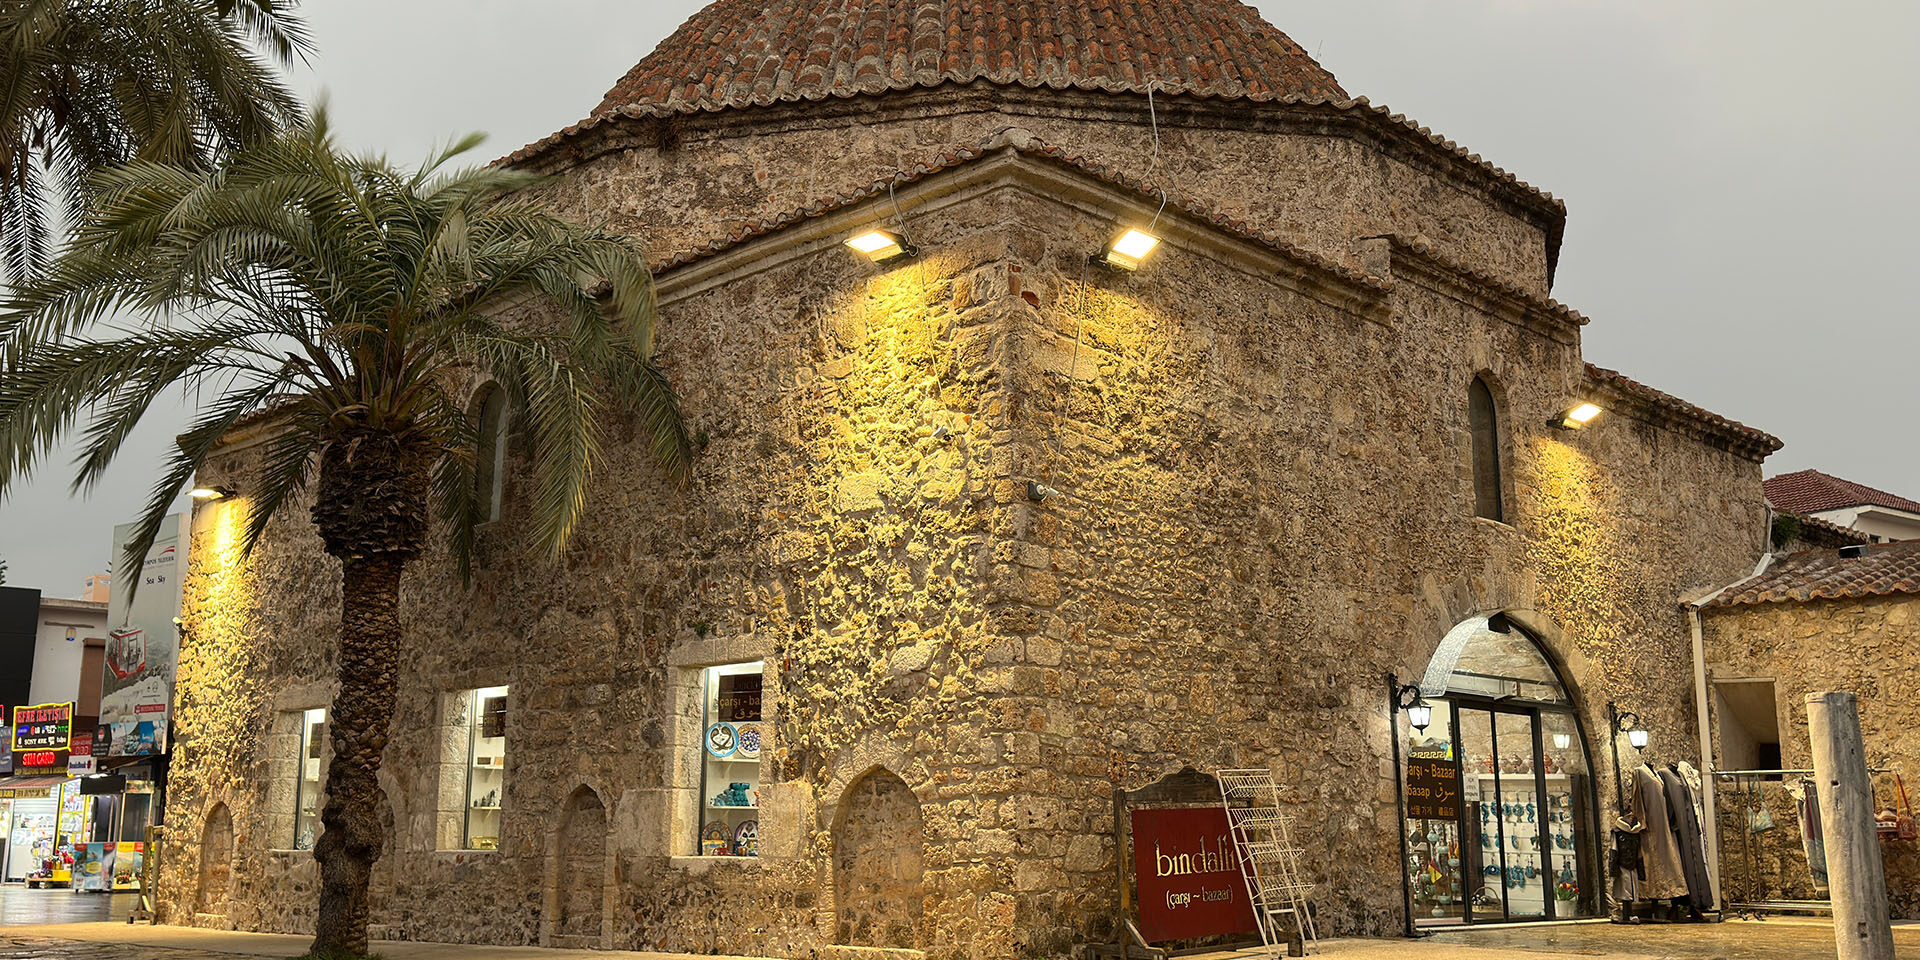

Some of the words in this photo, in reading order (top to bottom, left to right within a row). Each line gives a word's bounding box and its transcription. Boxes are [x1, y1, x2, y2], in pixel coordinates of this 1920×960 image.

[146, 577, 155, 585] Sea
[157, 575, 166, 585] Sky
[720, 698, 741, 709] çarşı
[37, 752, 56, 766] CARD
[1407, 764, 1423, 780] arşı
[1431, 763, 1456, 780] Bazaar
[1407, 784, 1431, 799] базар
[1201, 884, 1233, 904] bazaar)
